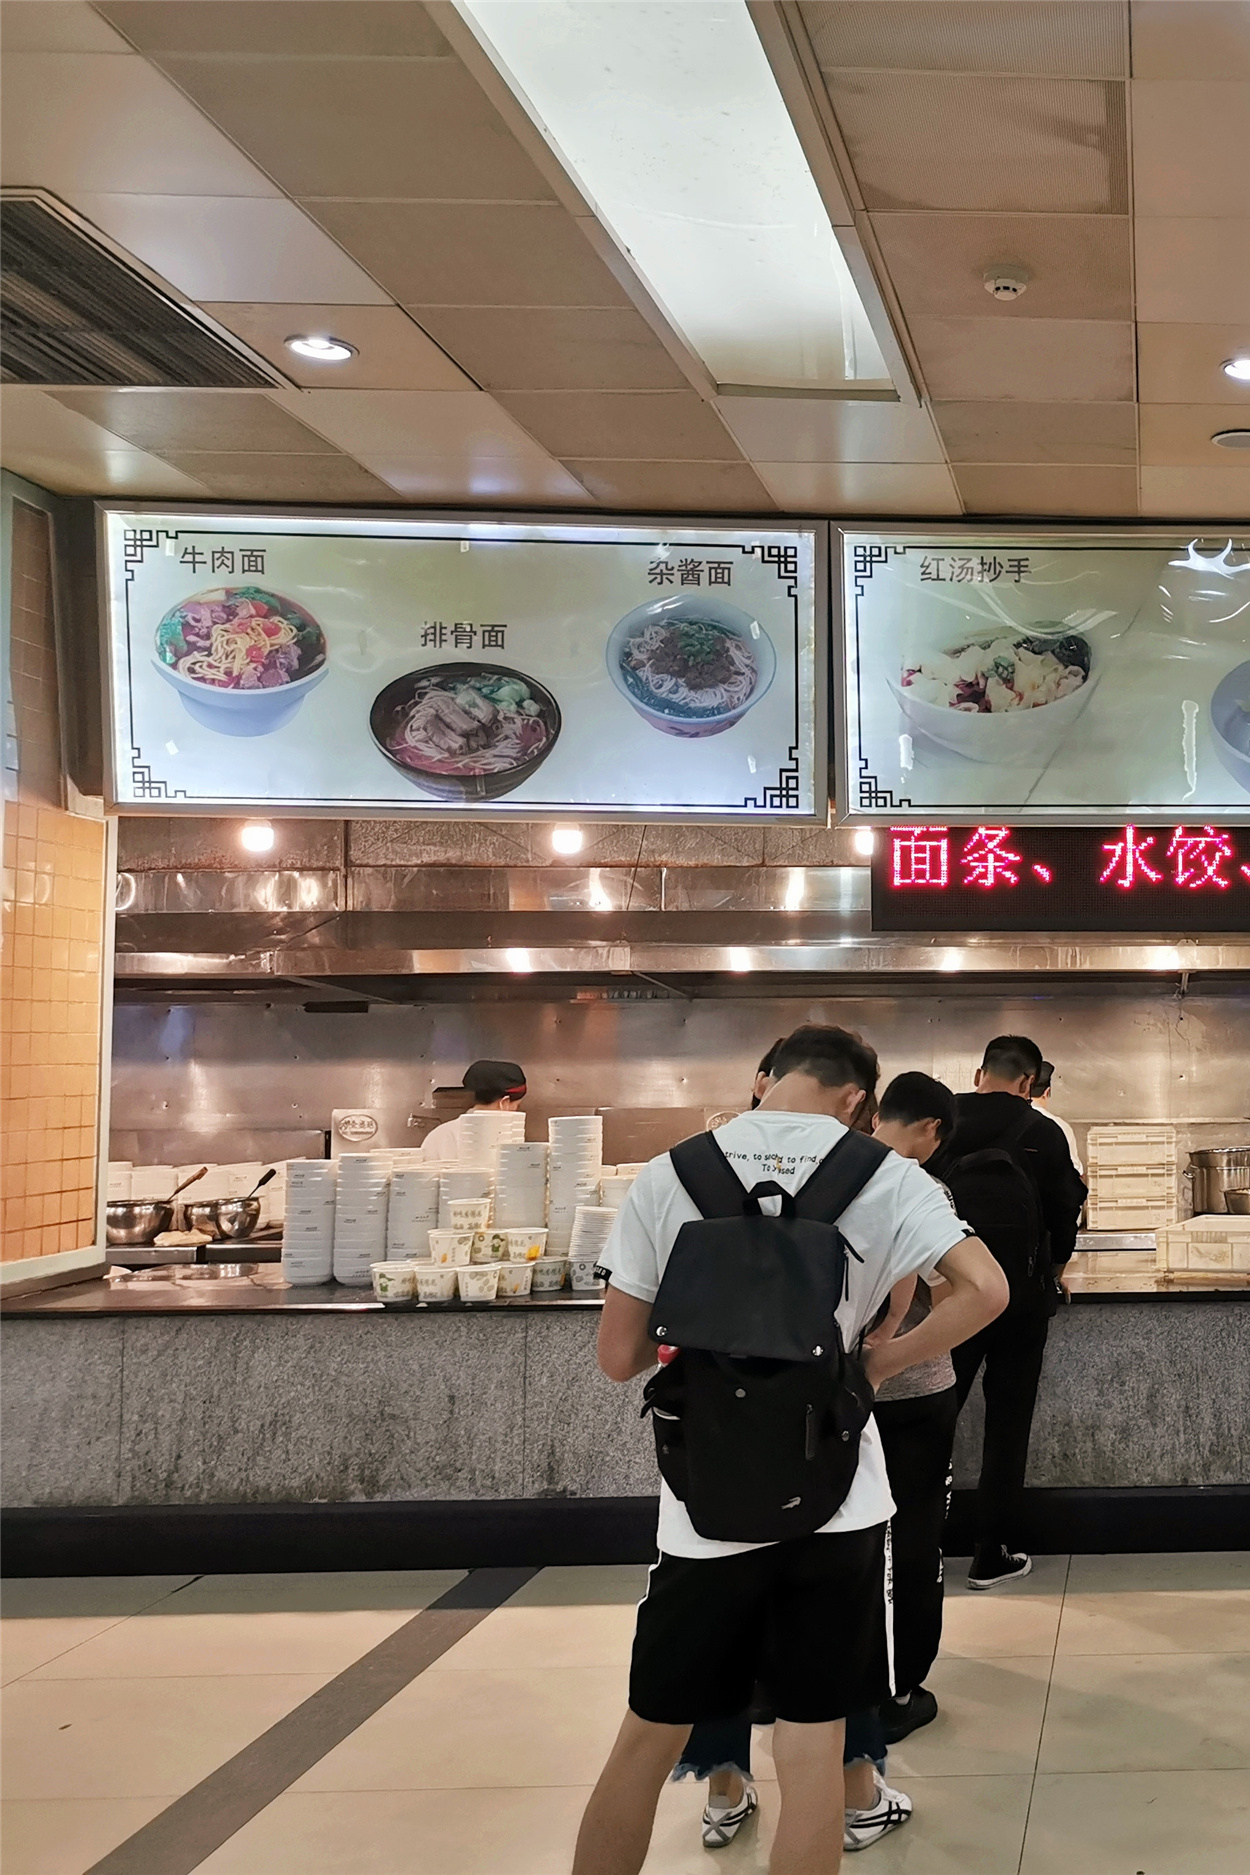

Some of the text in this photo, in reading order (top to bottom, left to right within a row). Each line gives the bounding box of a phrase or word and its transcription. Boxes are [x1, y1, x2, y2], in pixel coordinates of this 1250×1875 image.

[178, 544, 267, 576] 牛肉面
[647, 557, 734, 587] 杂酱面
[919, 555, 1032, 585] 红汤抄手
[420, 620, 508, 651] 排骨面
